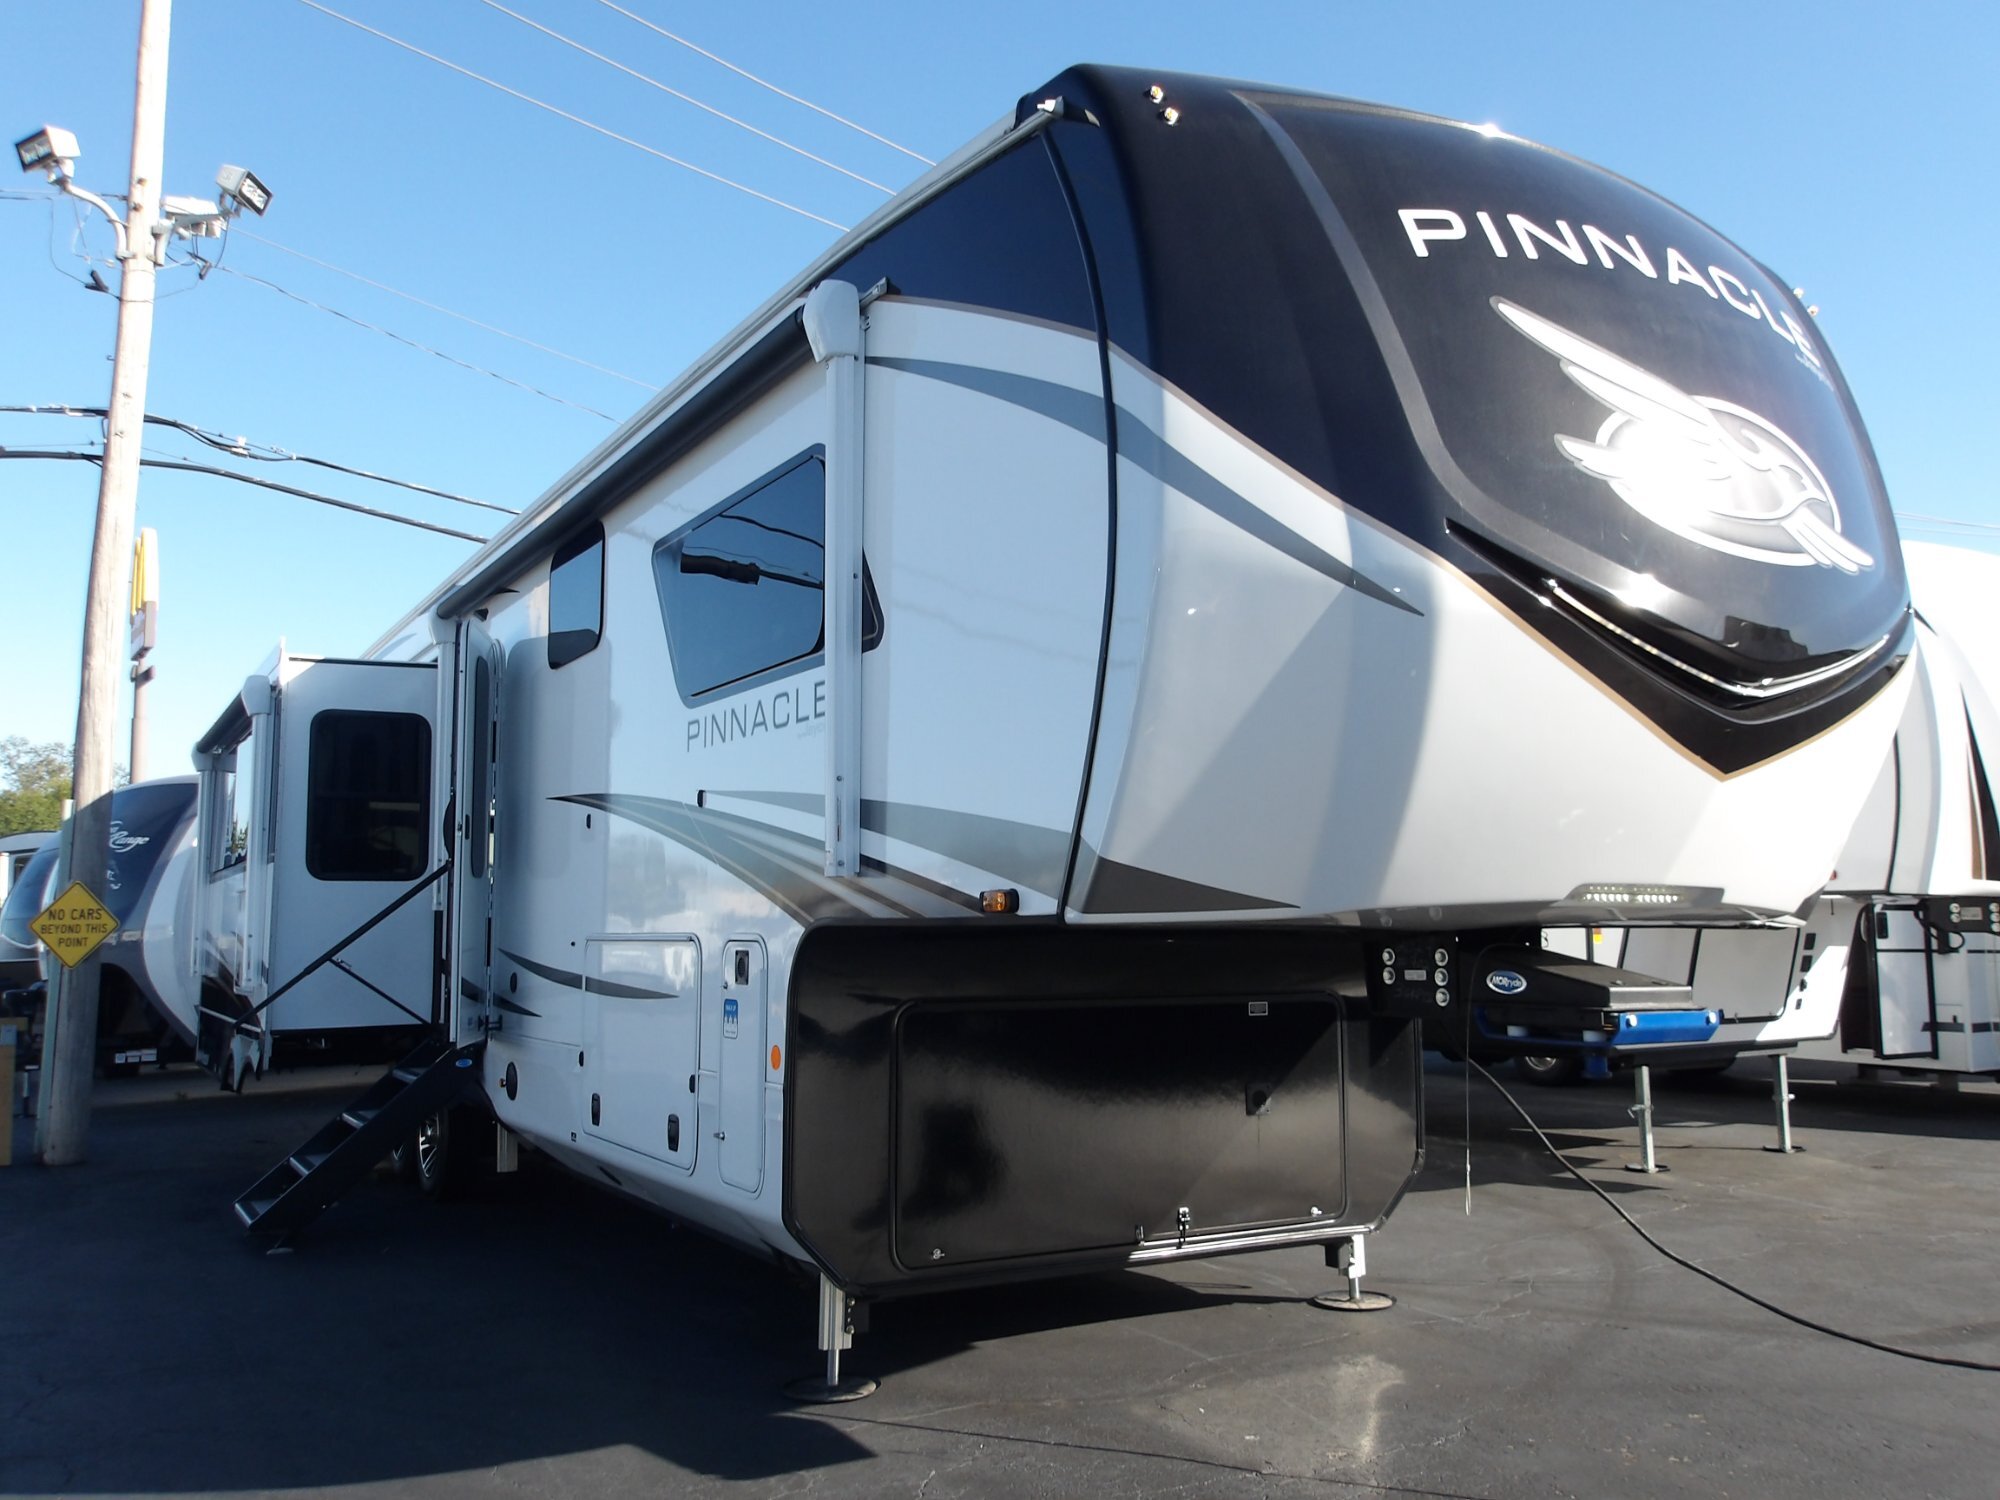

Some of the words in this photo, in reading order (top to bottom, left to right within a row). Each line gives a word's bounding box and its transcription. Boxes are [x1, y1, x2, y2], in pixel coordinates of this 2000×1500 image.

[1397, 208, 1821, 369] PINNACLE
[686, 680, 826, 752] PINNACLE
[48, 908, 65, 920] NO
[71, 908, 102, 920] CARS
[41, 923, 82, 934] BEYOND
[86, 923, 108, 933] THIS
[58, 937, 88, 947] POINT
